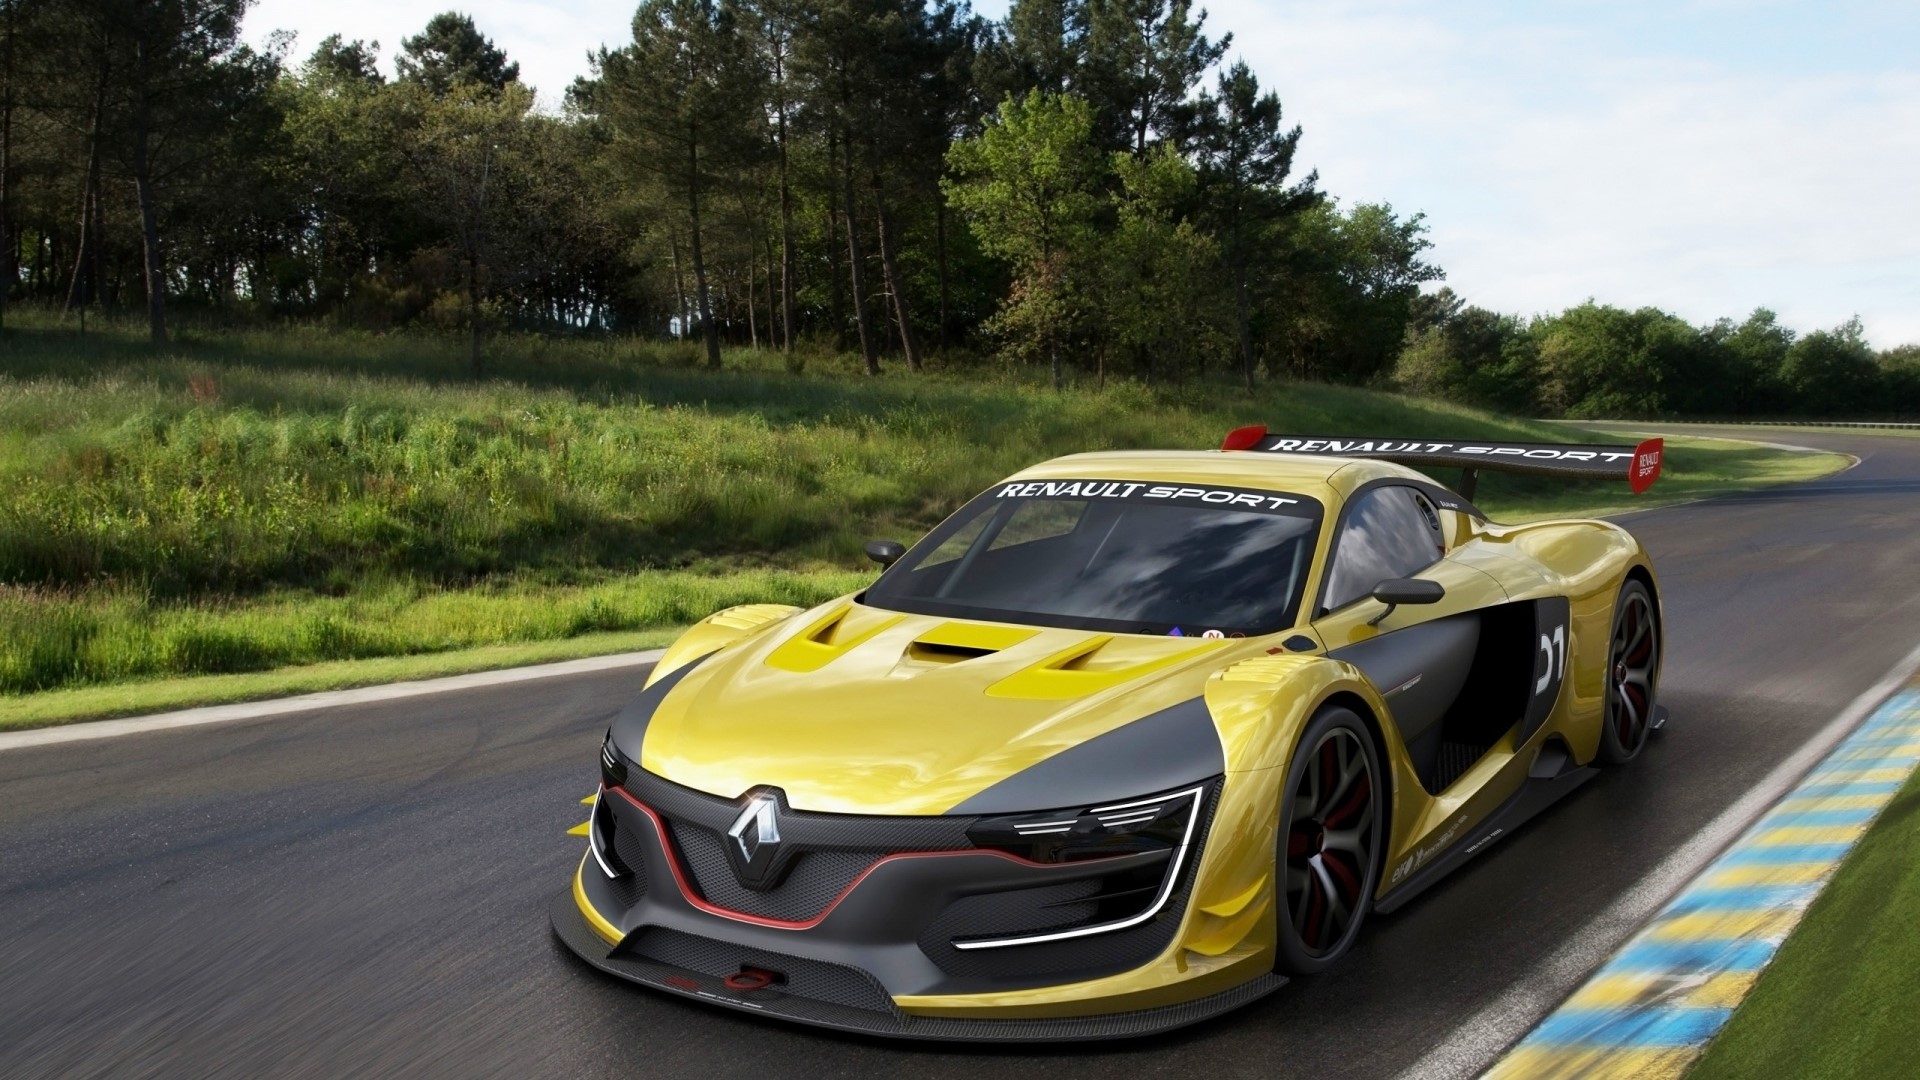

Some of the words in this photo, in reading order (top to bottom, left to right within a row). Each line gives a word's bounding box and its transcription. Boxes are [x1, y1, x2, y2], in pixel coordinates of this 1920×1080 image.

[1269, 438, 1453, 453] RENAULT
[1452, 446, 1635, 462] SPORT
[996, 482, 1147, 498] RENAULT
[1142, 486, 1299, 510] SPORT
